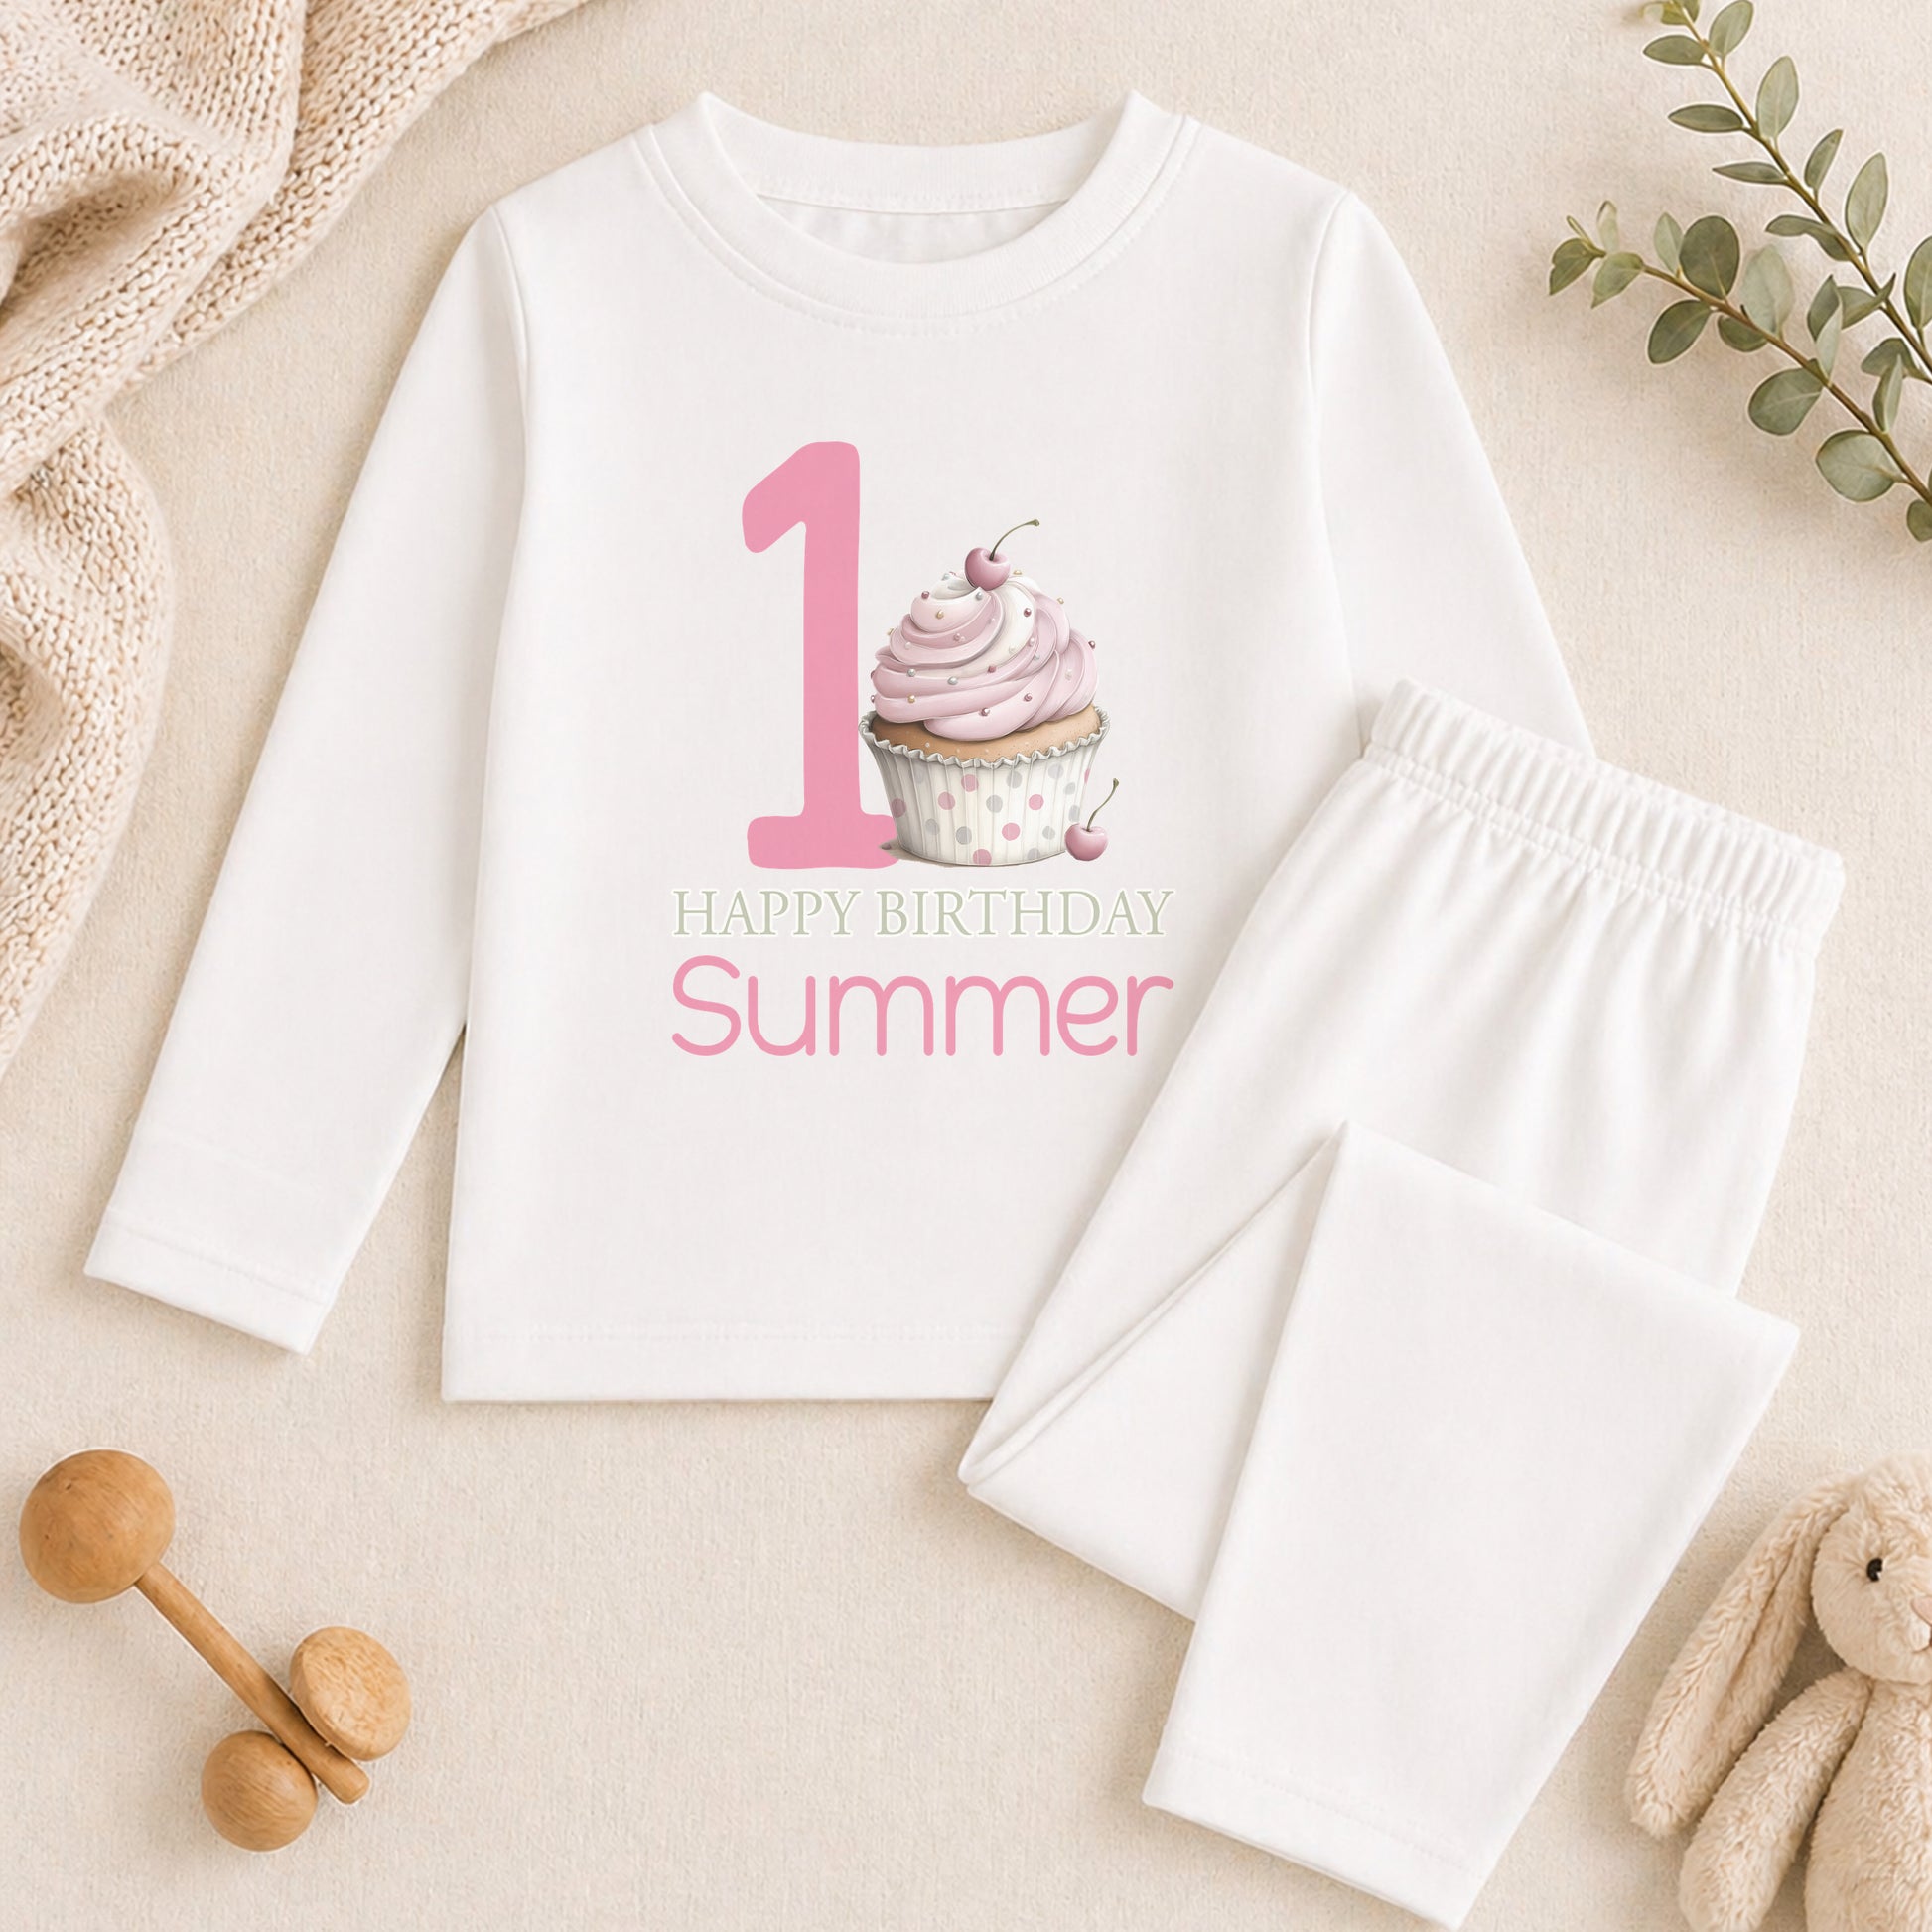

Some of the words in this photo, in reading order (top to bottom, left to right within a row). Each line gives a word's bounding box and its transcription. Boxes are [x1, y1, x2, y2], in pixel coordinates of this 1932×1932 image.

[742, 441, 897, 870] 1
[673, 890, 862, 936] HAPPY
[877, 889, 1173, 936] BIRTHDAY
[671, 955, 1173, 1056] Summer
